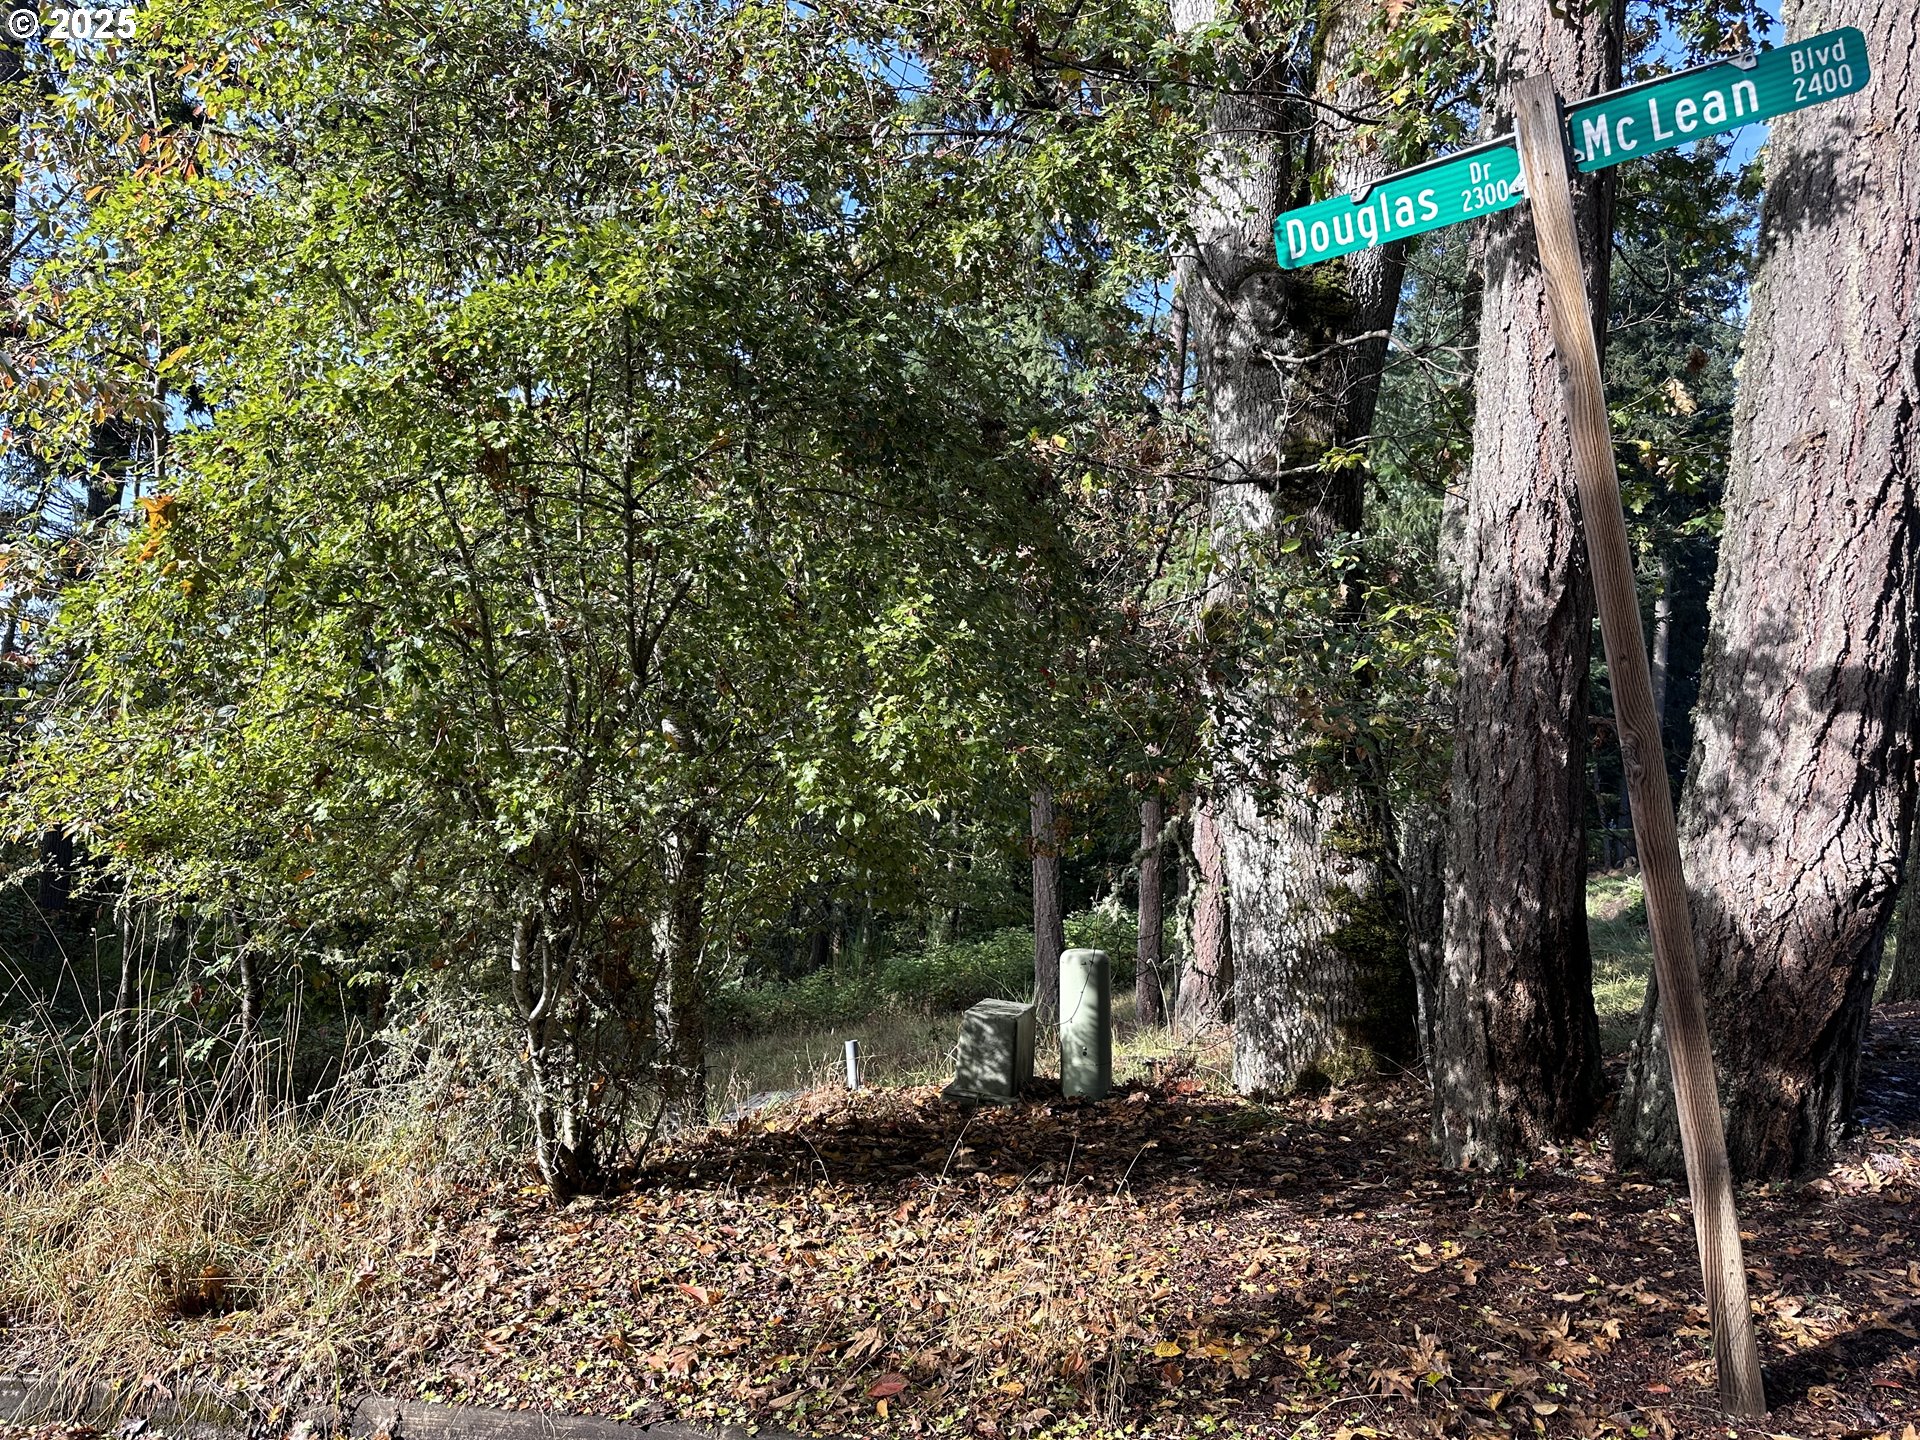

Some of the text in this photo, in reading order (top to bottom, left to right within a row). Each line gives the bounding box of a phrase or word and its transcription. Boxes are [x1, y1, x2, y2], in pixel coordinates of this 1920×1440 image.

[1790, 38, 1847, 75] Blvd
[1793, 64, 1853, 103] 2400
[1582, 79, 1760, 161] Mc Lean
[1470, 161, 1491, 185] Dr
[1462, 178, 1509, 213] 2300
[1286, 188, 1439, 260] Douglas
